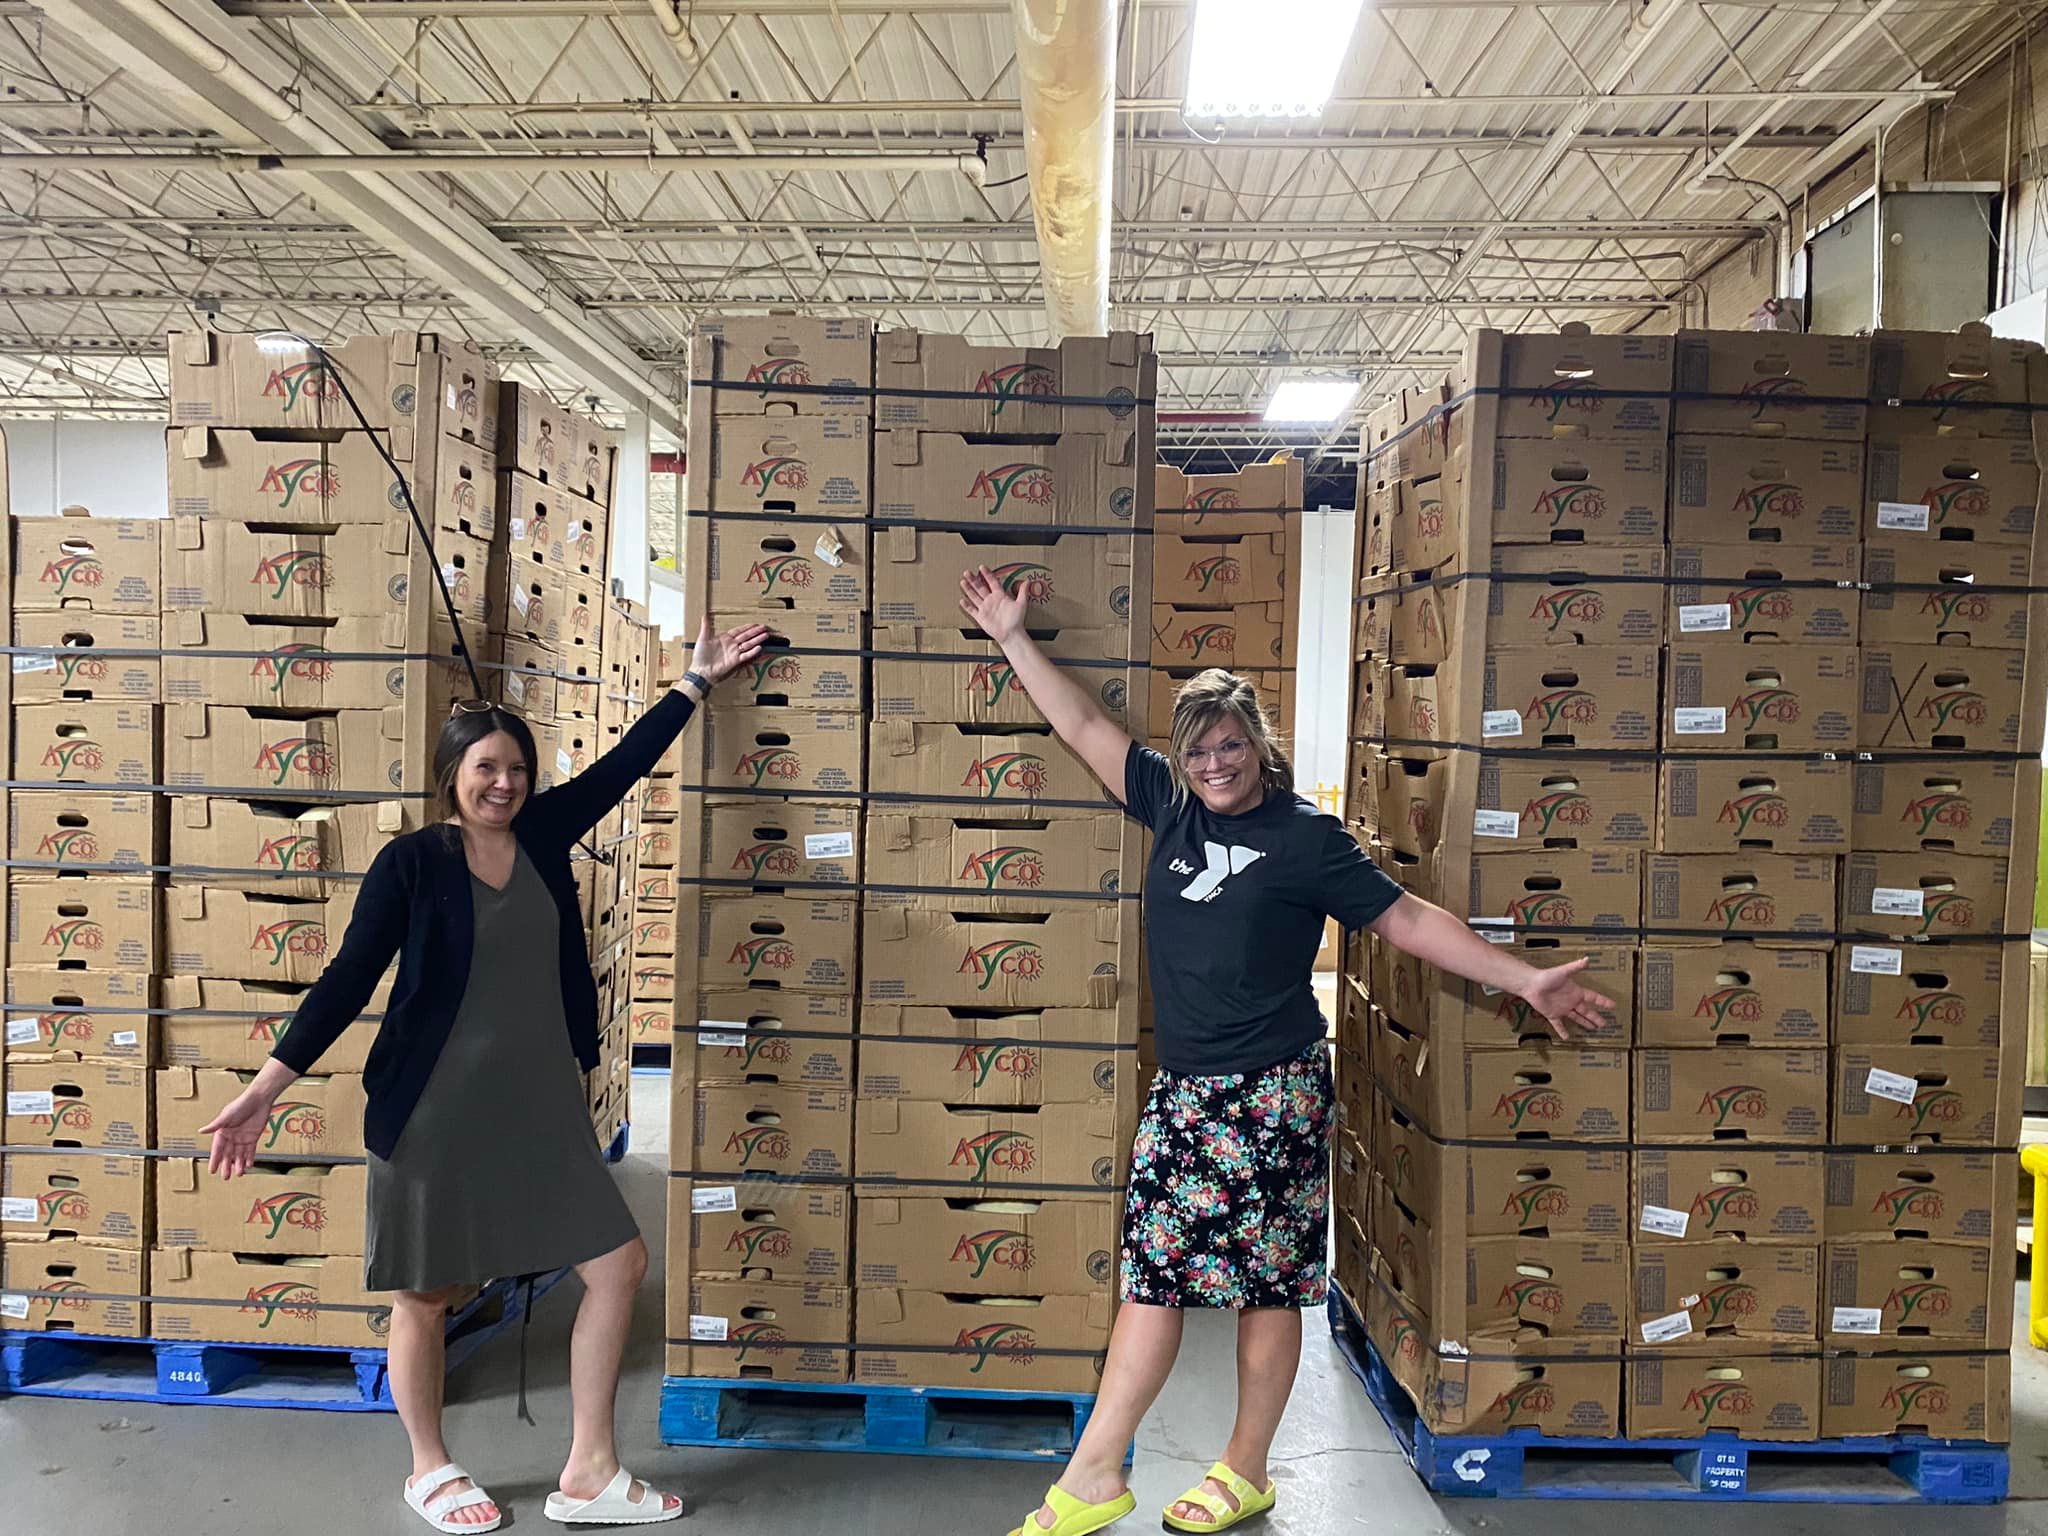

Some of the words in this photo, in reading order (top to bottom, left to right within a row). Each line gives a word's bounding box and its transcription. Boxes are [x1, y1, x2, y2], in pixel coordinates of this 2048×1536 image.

[248, 1016, 292, 1056] Ay
[262, 1102, 326, 1149] yco
[170, 1371, 201, 1383] 4840
[1705, 1467, 1745, 1477] PROPERTY
